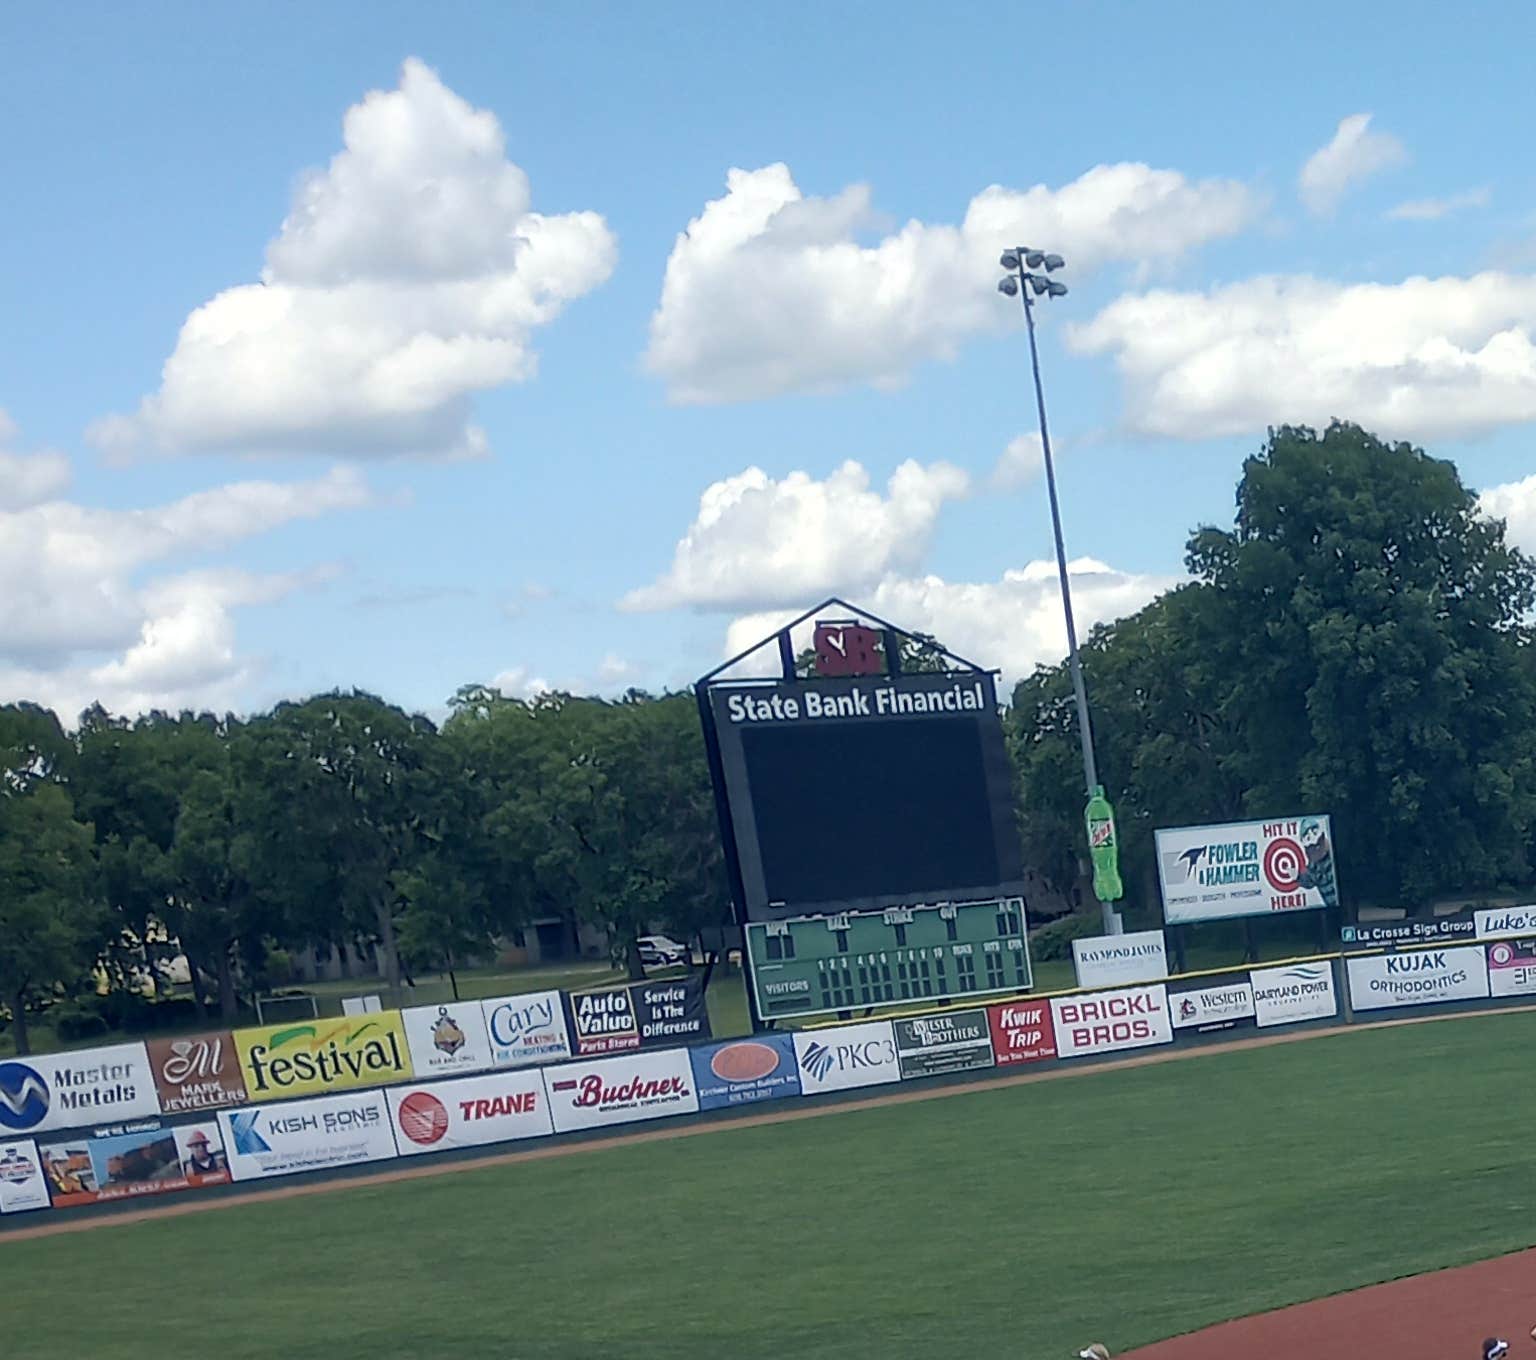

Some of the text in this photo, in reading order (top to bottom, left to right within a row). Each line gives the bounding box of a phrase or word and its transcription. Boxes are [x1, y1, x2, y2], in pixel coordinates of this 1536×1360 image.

[728, 682, 985, 722] State Bank Financial
[1263, 821, 1298, 838] HIT IT
[1208, 841, 1257, 865] FOWLER
[1206, 863, 1260, 887] HAMMER
[1357, 929, 1370, 941] La
[1373, 926, 1411, 939] Crosse
[1413, 923, 1438, 936] Sign
[1440, 920, 1473, 932] Group
[817, 960, 825, 971] 1
[841, 957, 848, 969] 3
[857, 955, 864, 966] 4
[1080, 943, 1162, 963] RAYMOND JAMES
[1386, 952, 1447, 975] KUJAK
[765, 981, 809, 995] VISITORS
[1300, 981, 1329, 996] POWER
[1370, 970, 1467, 994] ORTHODONTICS
[579, 993, 627, 1014] Auto
[644, 988, 685, 1005] Service
[1200, 989, 1248, 1009] Western
[652, 1003, 685, 1020] Is The
[1000, 1007, 1043, 1029] KWIK
[1059, 994, 1161, 1025] BRICKL
[491, 998, 553, 1046] Cary
[578, 1014, 633, 1034] Value
[642, 1019, 700, 1038] Difference
[1006, 1029, 1042, 1048] TRIP
[1072, 1020, 1157, 1048] BROS.
[580, 1040, 607, 1053] Parts
[248, 1031, 404, 1091] festival
[54, 1062, 135, 1089] Master
[60, 1084, 136, 1111] Metals
[181, 1079, 223, 1098] MARK
[572, 1074, 685, 1108] Buchner
[163, 1090, 246, 1112] JEWELLERS
[459, 1091, 536, 1121] TRANE
[269, 1105, 380, 1135] KISH SONS
